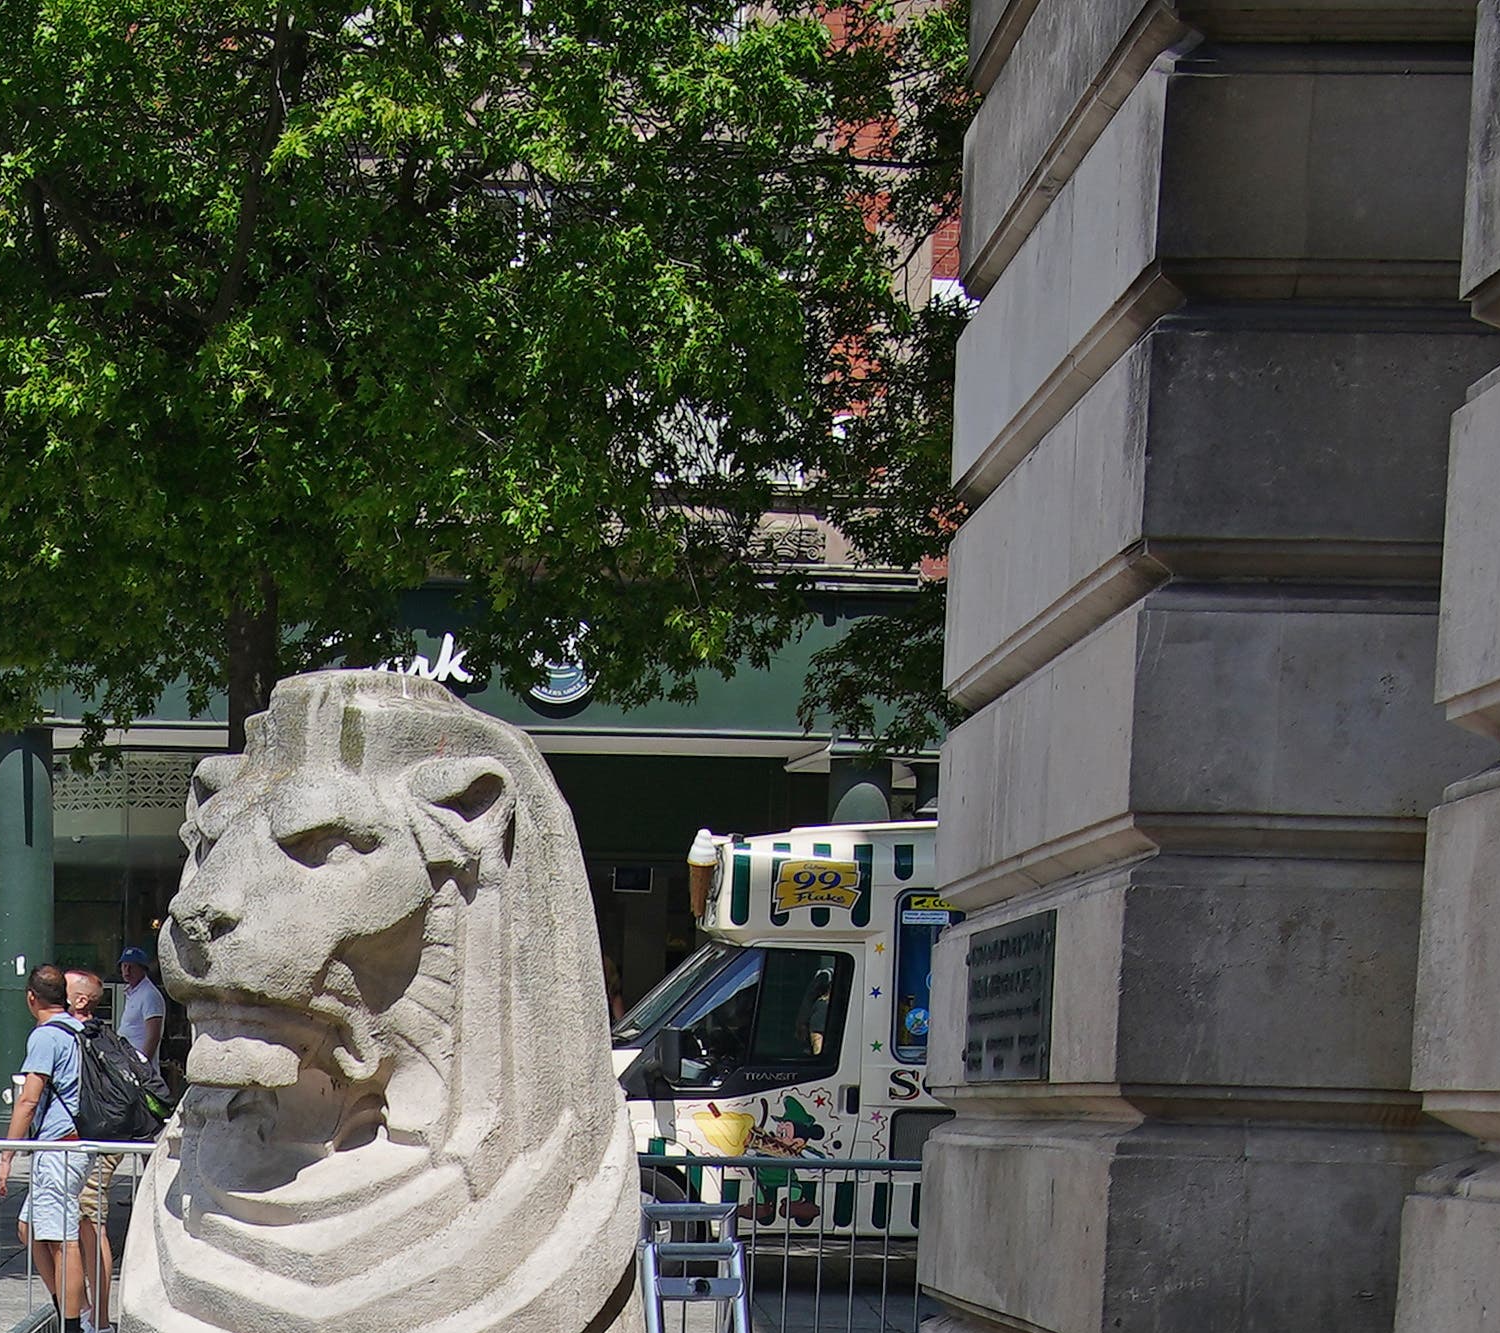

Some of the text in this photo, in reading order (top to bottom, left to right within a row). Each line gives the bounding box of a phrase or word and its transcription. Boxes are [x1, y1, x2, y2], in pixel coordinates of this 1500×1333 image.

[793, 870, 841, 890] 99
[794, 890, 845, 903] Flake
[745, 1072, 798, 1081] TRANSIT
